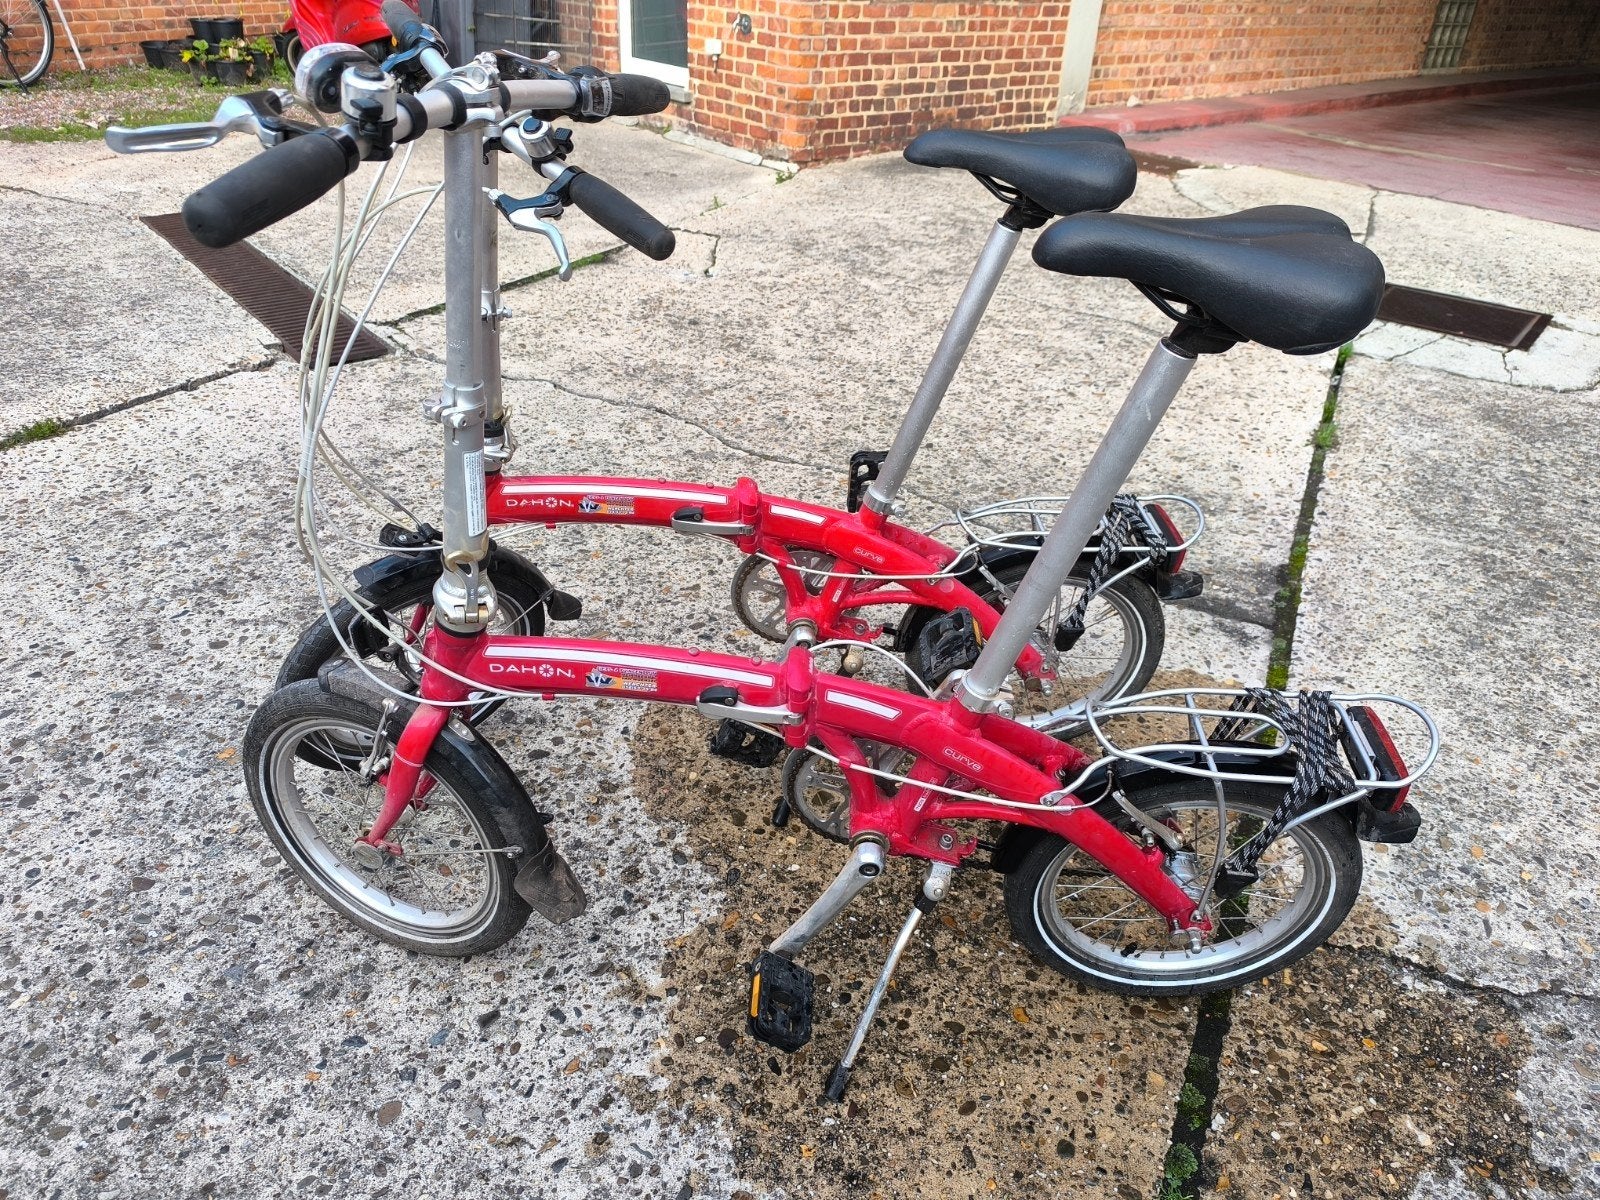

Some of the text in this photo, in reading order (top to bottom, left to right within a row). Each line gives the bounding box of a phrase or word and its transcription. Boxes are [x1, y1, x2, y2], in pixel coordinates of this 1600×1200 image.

[506, 496, 572, 508] DAHON
[854, 547, 883, 563] curve
[488, 663, 573, 678] DAHON
[944, 748, 981, 772] curve
